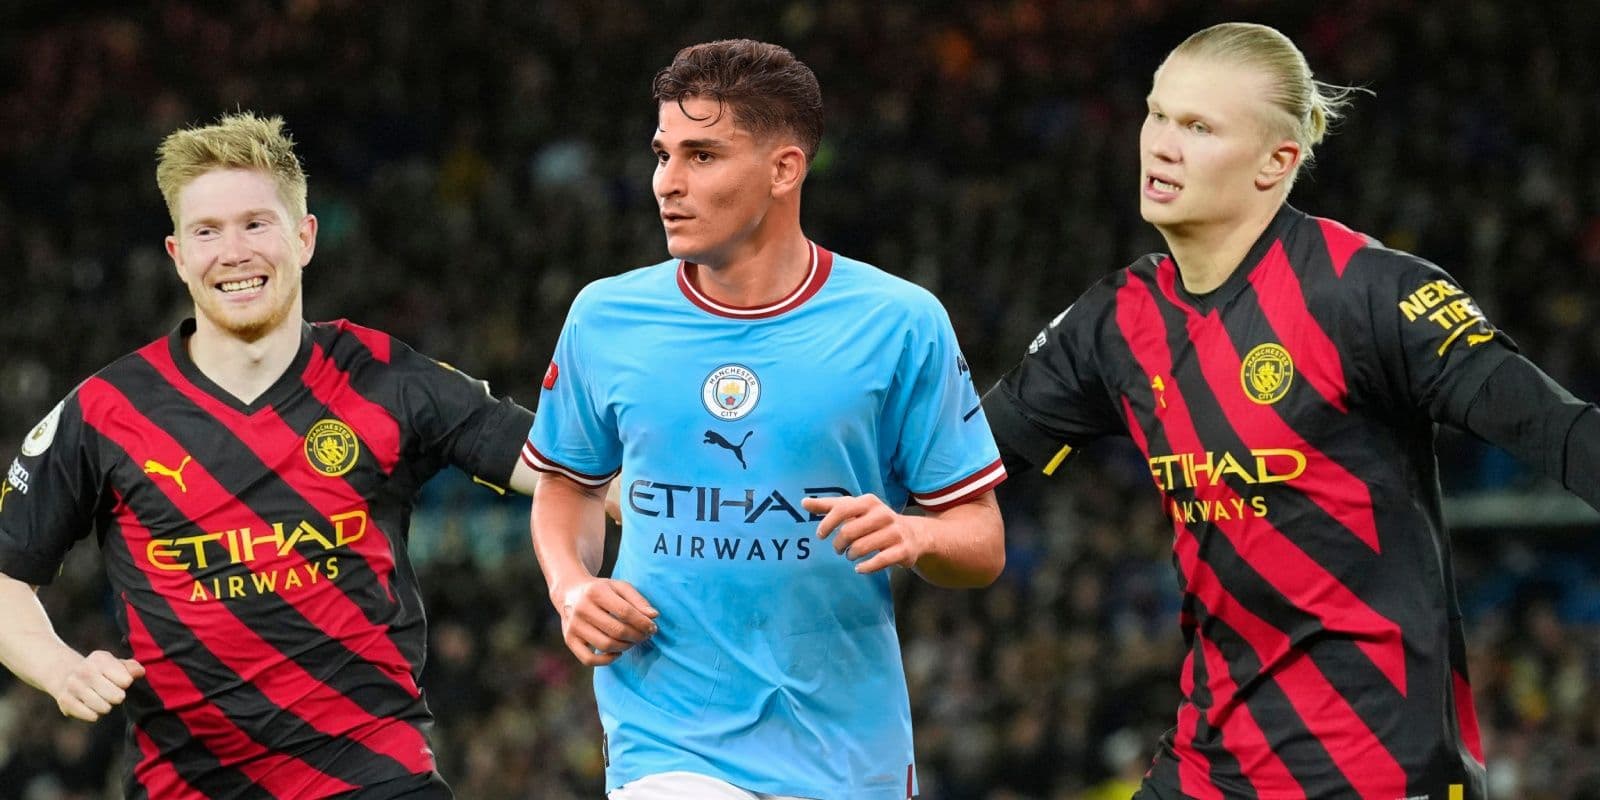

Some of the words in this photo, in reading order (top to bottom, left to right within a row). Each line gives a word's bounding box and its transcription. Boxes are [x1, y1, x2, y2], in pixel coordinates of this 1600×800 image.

[709, 367, 756, 387] MANCHESTER
[325, 465, 343, 473] CITY
[1148, 448, 1307, 490] ETIHAD
[146, 510, 367, 571] ETIHAD
[653, 532, 811, 561] AIRWAYS
[190, 557, 339, 602] AIRWAYS
